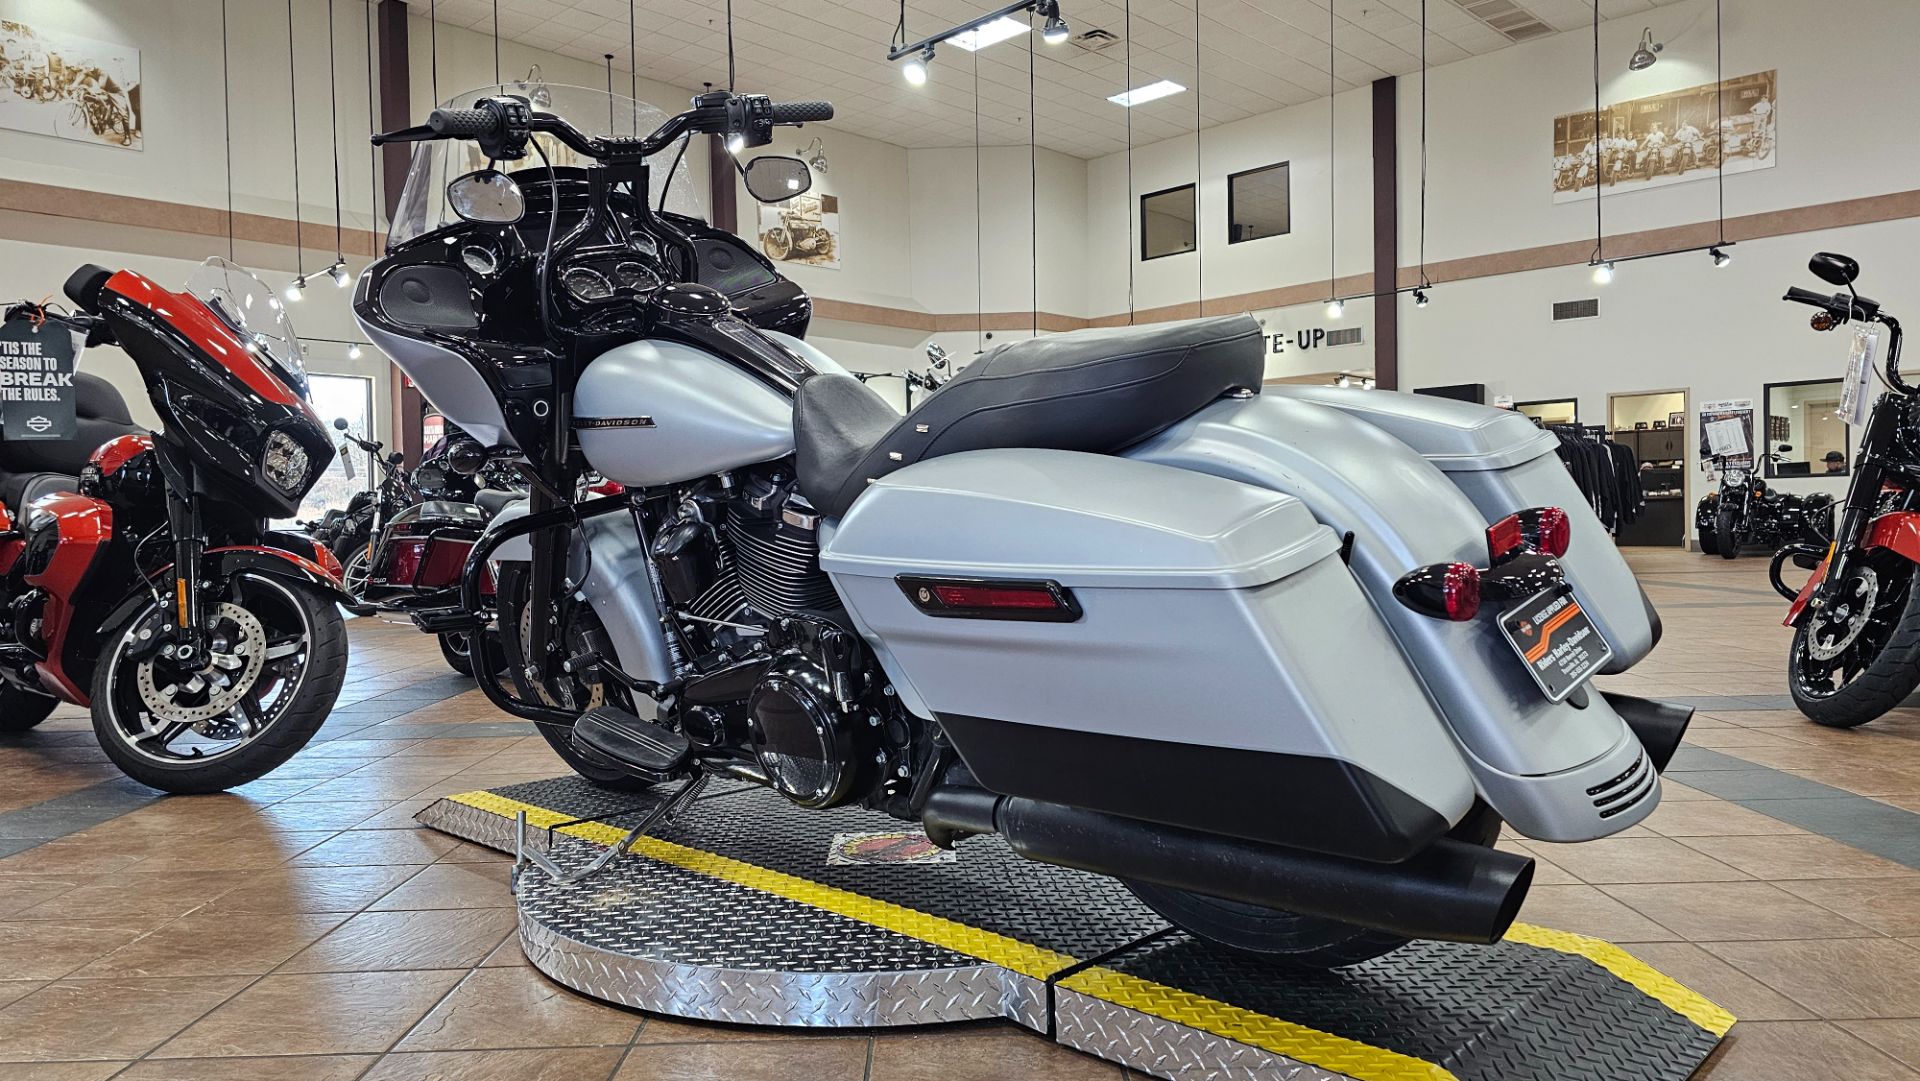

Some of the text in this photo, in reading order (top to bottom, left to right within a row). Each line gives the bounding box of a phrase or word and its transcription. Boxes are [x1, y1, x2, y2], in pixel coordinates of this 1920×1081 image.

[21, 342, 42, 355] THE
[1263, 328, 1325, 354] TE-UP
[0, 356, 57, 371] SEASON TO
[1, 371, 74, 387] BREAK
[1, 387, 61, 401] THE RULES.
